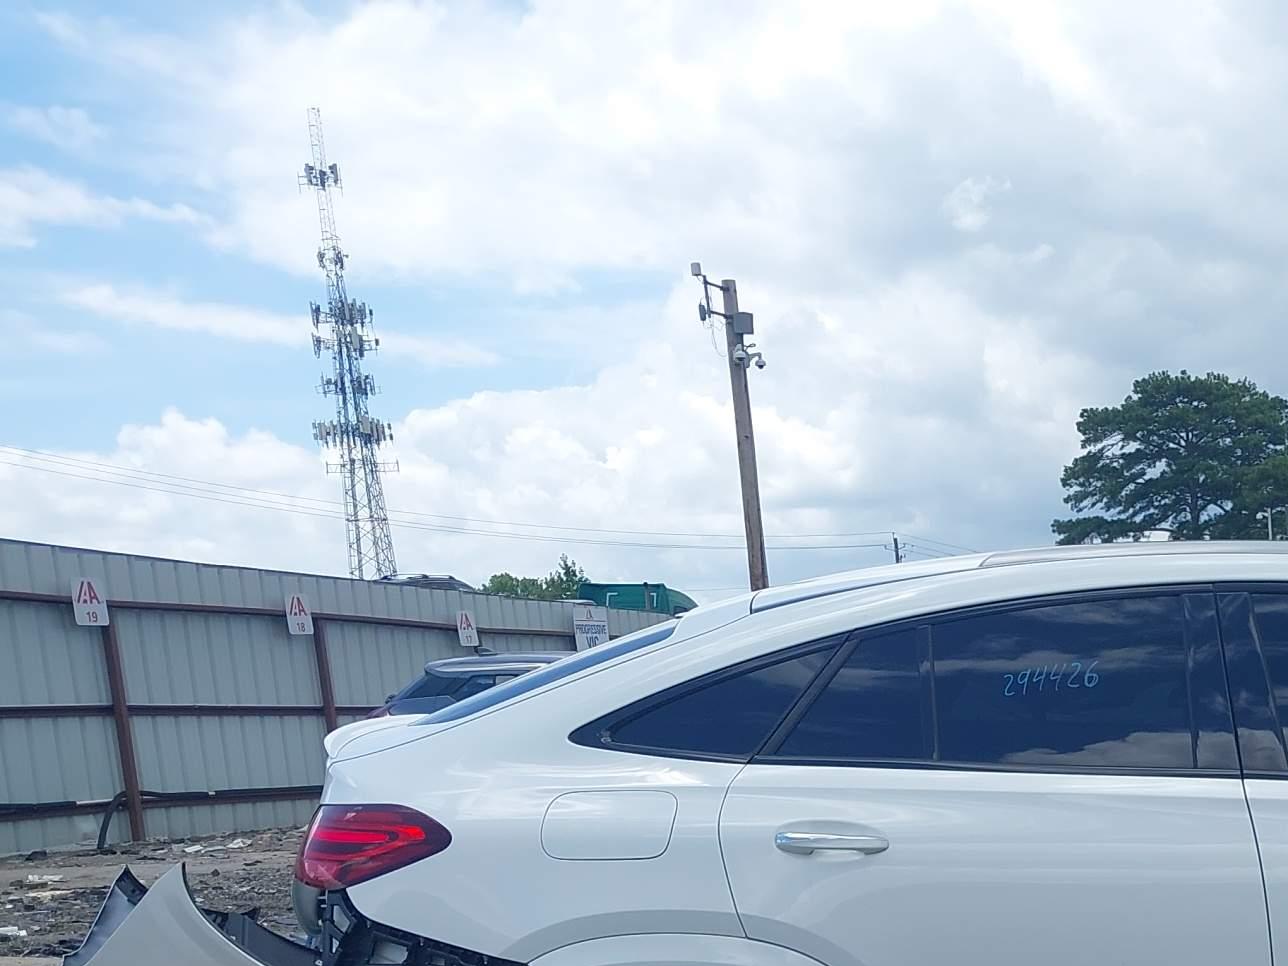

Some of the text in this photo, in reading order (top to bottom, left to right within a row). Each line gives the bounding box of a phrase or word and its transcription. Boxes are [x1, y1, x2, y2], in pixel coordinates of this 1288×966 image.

[85, 610, 99, 623] 19
[296, 622, 306, 633] 18
[1003, 660, 1099, 697] 294426
